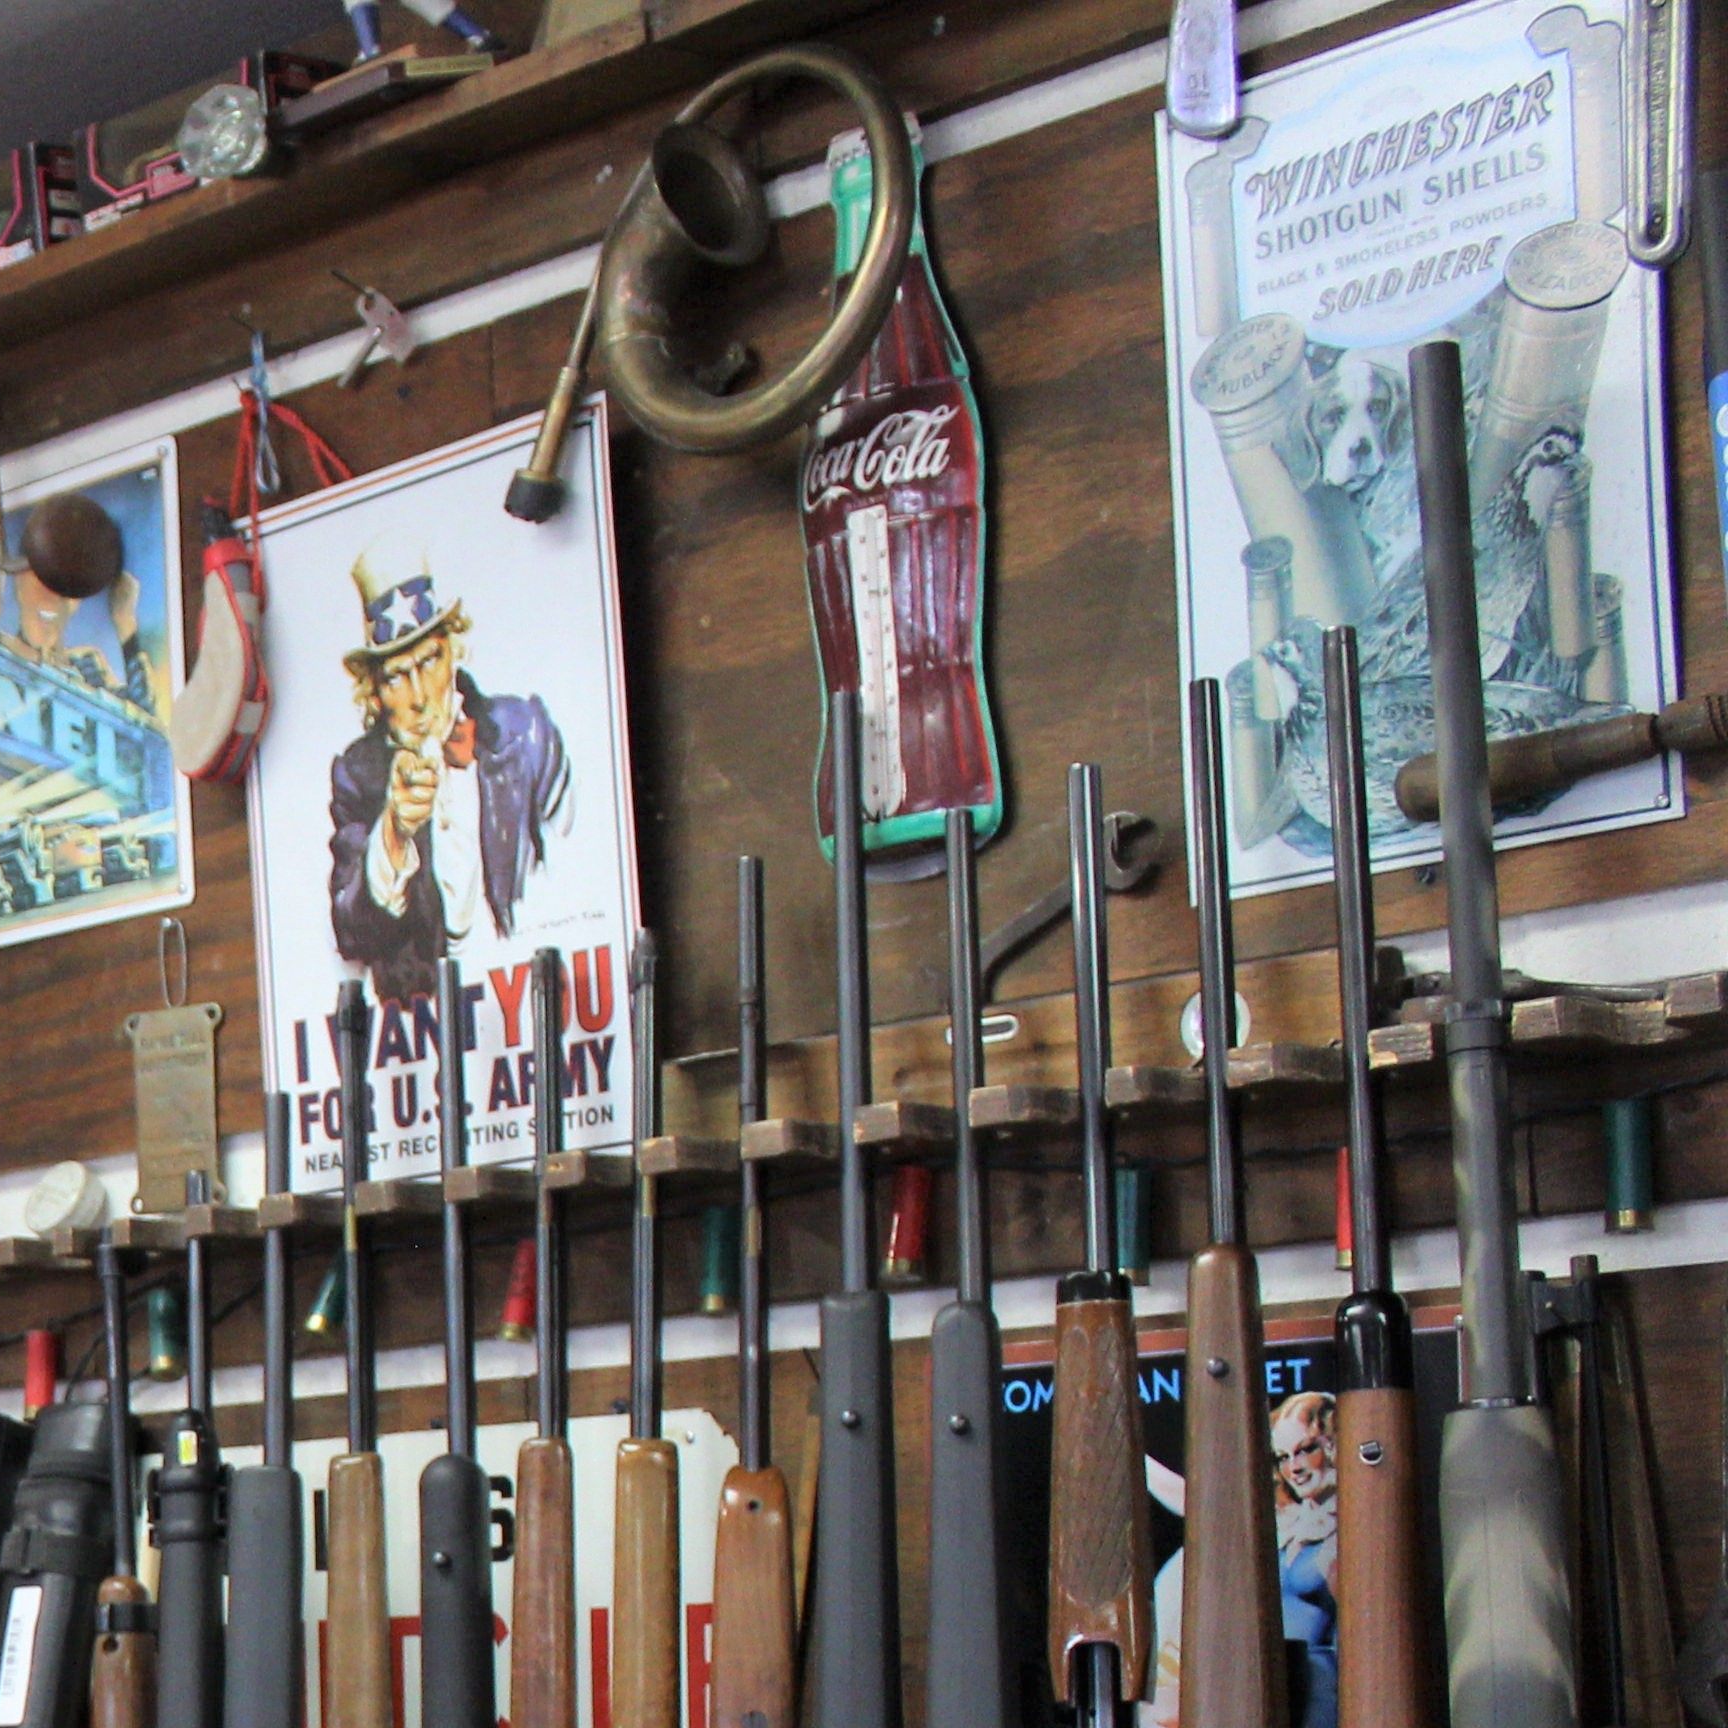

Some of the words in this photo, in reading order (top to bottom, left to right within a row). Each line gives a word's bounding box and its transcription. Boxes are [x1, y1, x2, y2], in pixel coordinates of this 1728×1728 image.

[1244, 69, 1555, 222] WINCHESTER
[1255, 187, 1404, 260] SHOTGUN
[1422, 141, 1547, 206] SHELLS
[1258, 269, 1307, 296] BLACK
[1334, 225, 1440, 273] SMOKELESS
[1450, 192, 1548, 234] POWDERS
[1312, 270, 1405, 322] SOLD
[1407, 235, 1503, 293] HERE
[294, 1019, 310, 1084] I
[488, 943, 613, 1048] YU
[305, 1141, 389, 1173] NEAST
[398, 1115, 520, 1158] RECTING
[528, 1104, 614, 1138] STION
[390, 1072, 474, 1130] U..
[1265, 1358, 1312, 1394] ET
